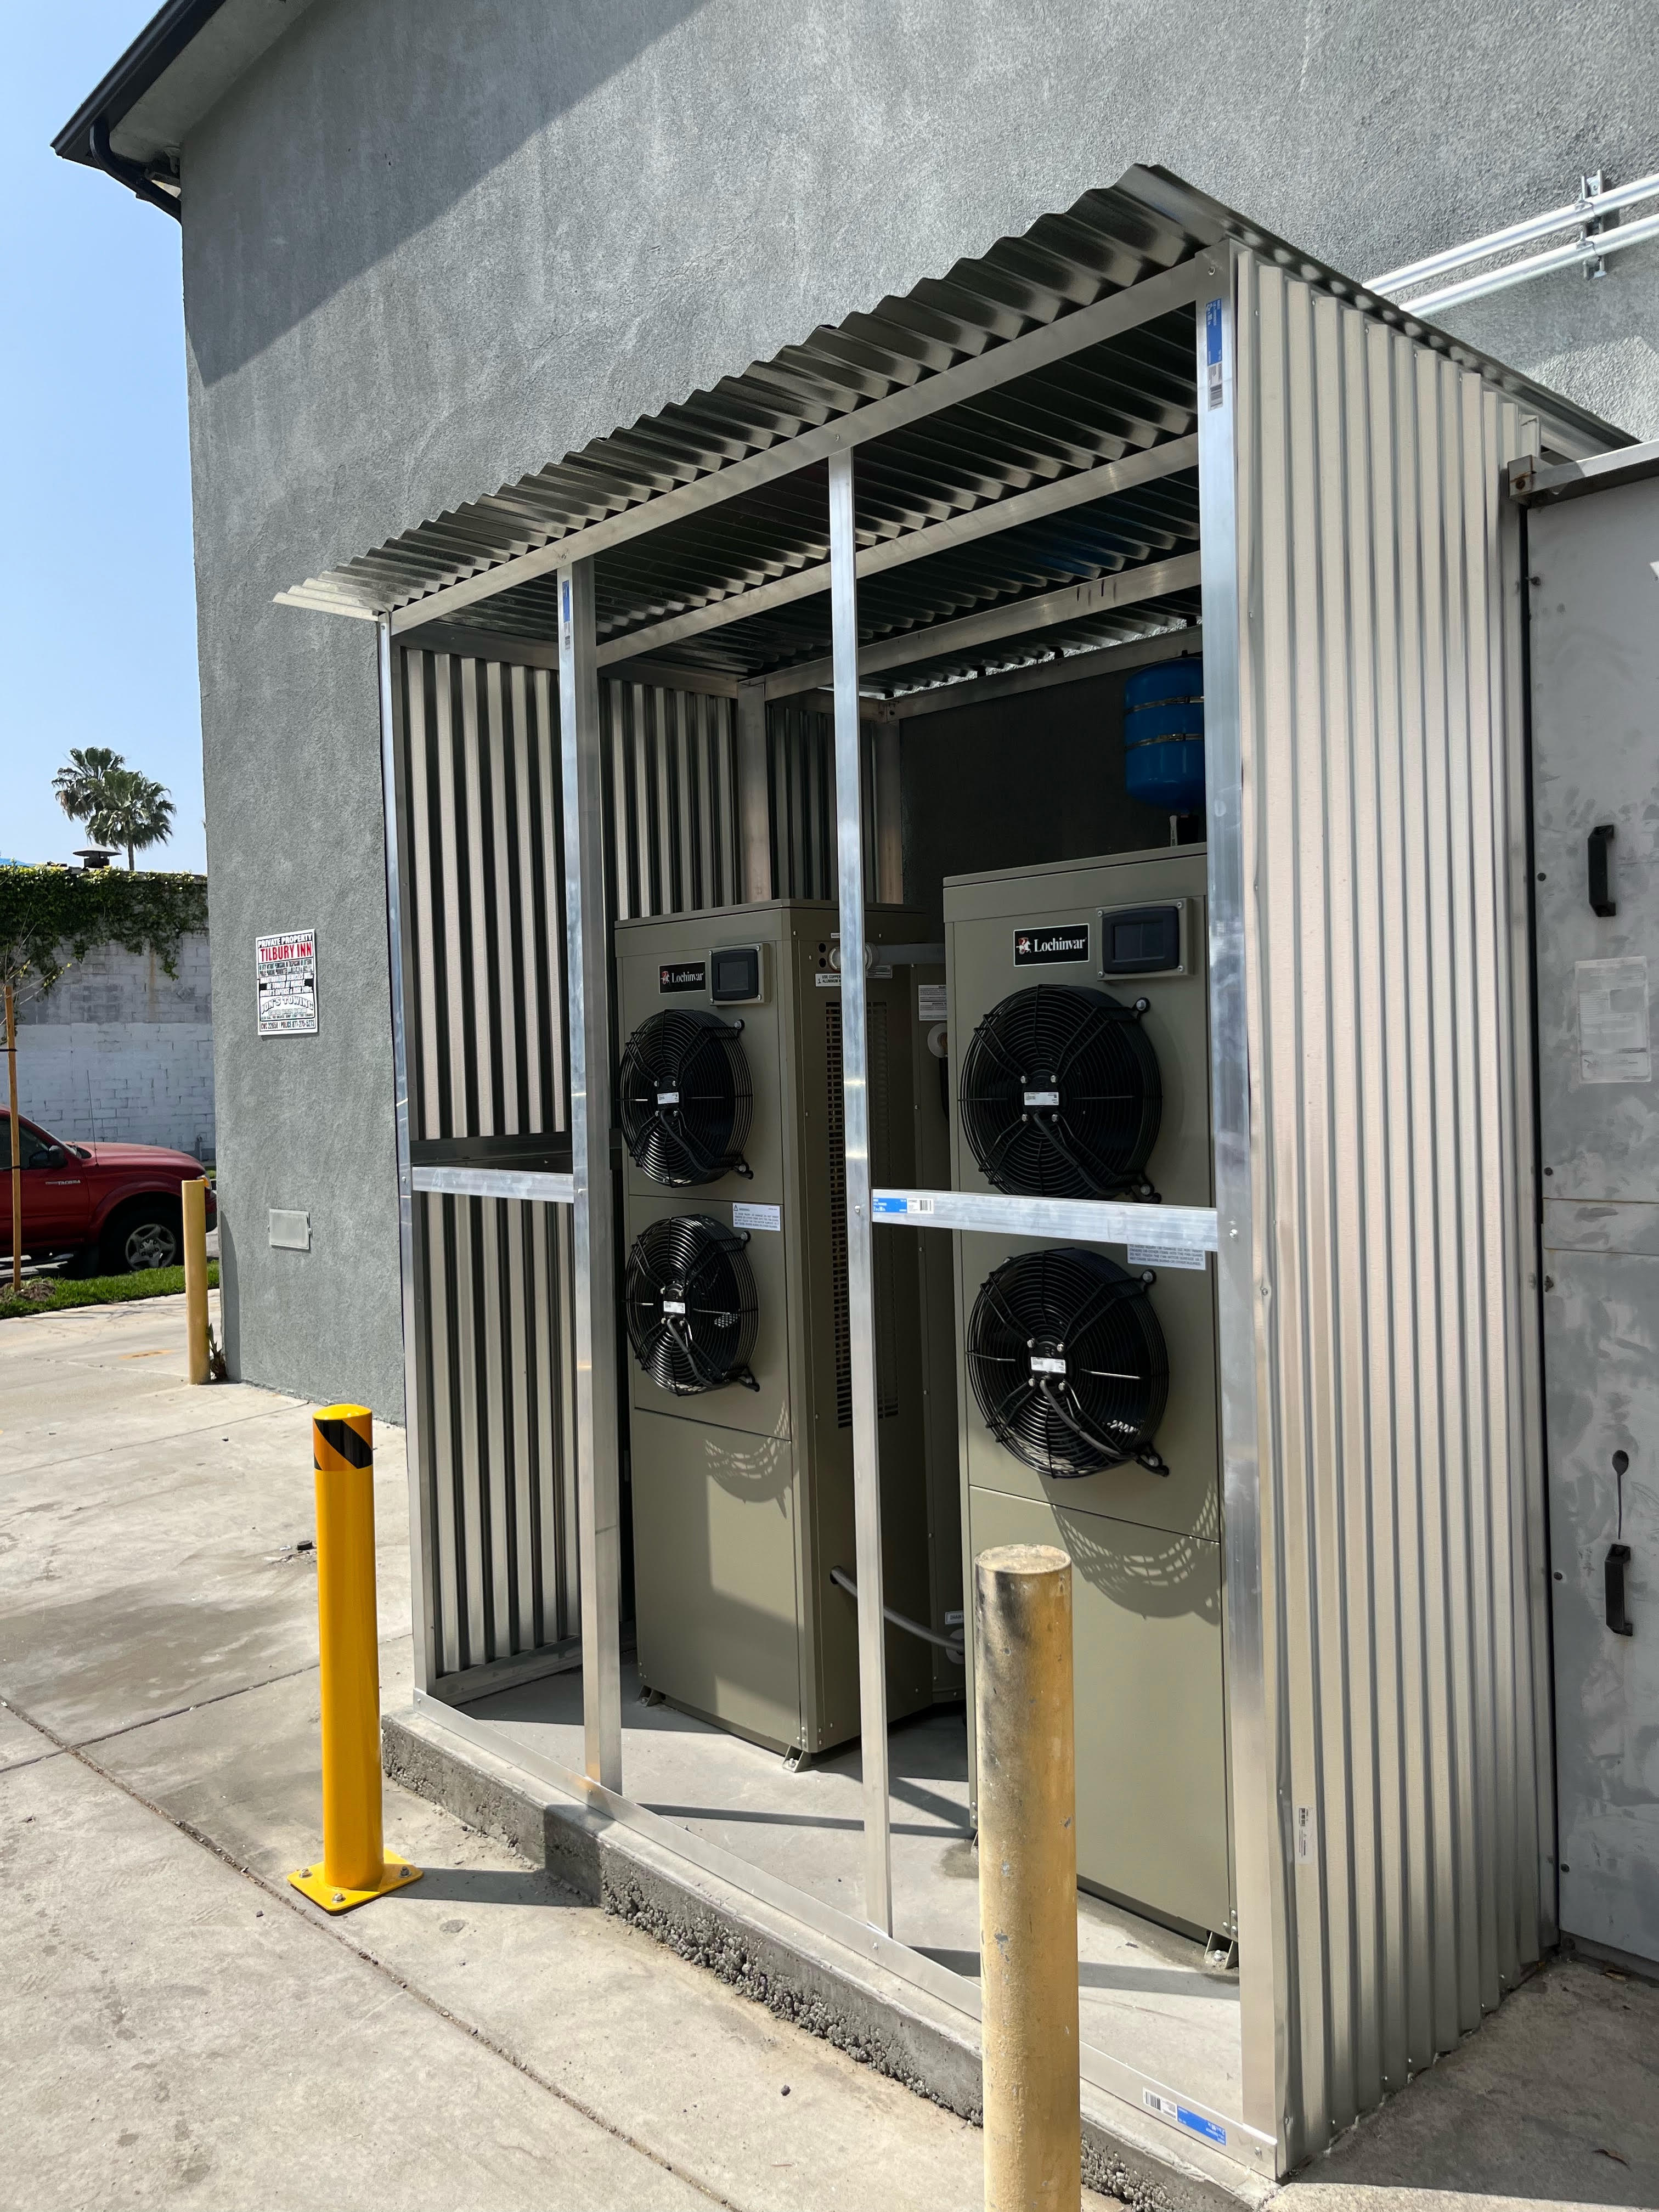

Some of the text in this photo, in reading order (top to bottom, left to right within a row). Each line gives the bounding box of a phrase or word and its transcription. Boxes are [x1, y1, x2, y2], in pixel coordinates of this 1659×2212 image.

[258, 933, 312, 948] PRIVATE PROPERTY
[1034, 937, 1085, 952] Lochinvar
[261, 942, 312, 962] TILBURY INN
[672, 971, 704, 983] Lochinvar
[262, 997, 281, 1014] JON'S
[282, 995, 314, 1010] TOWING
